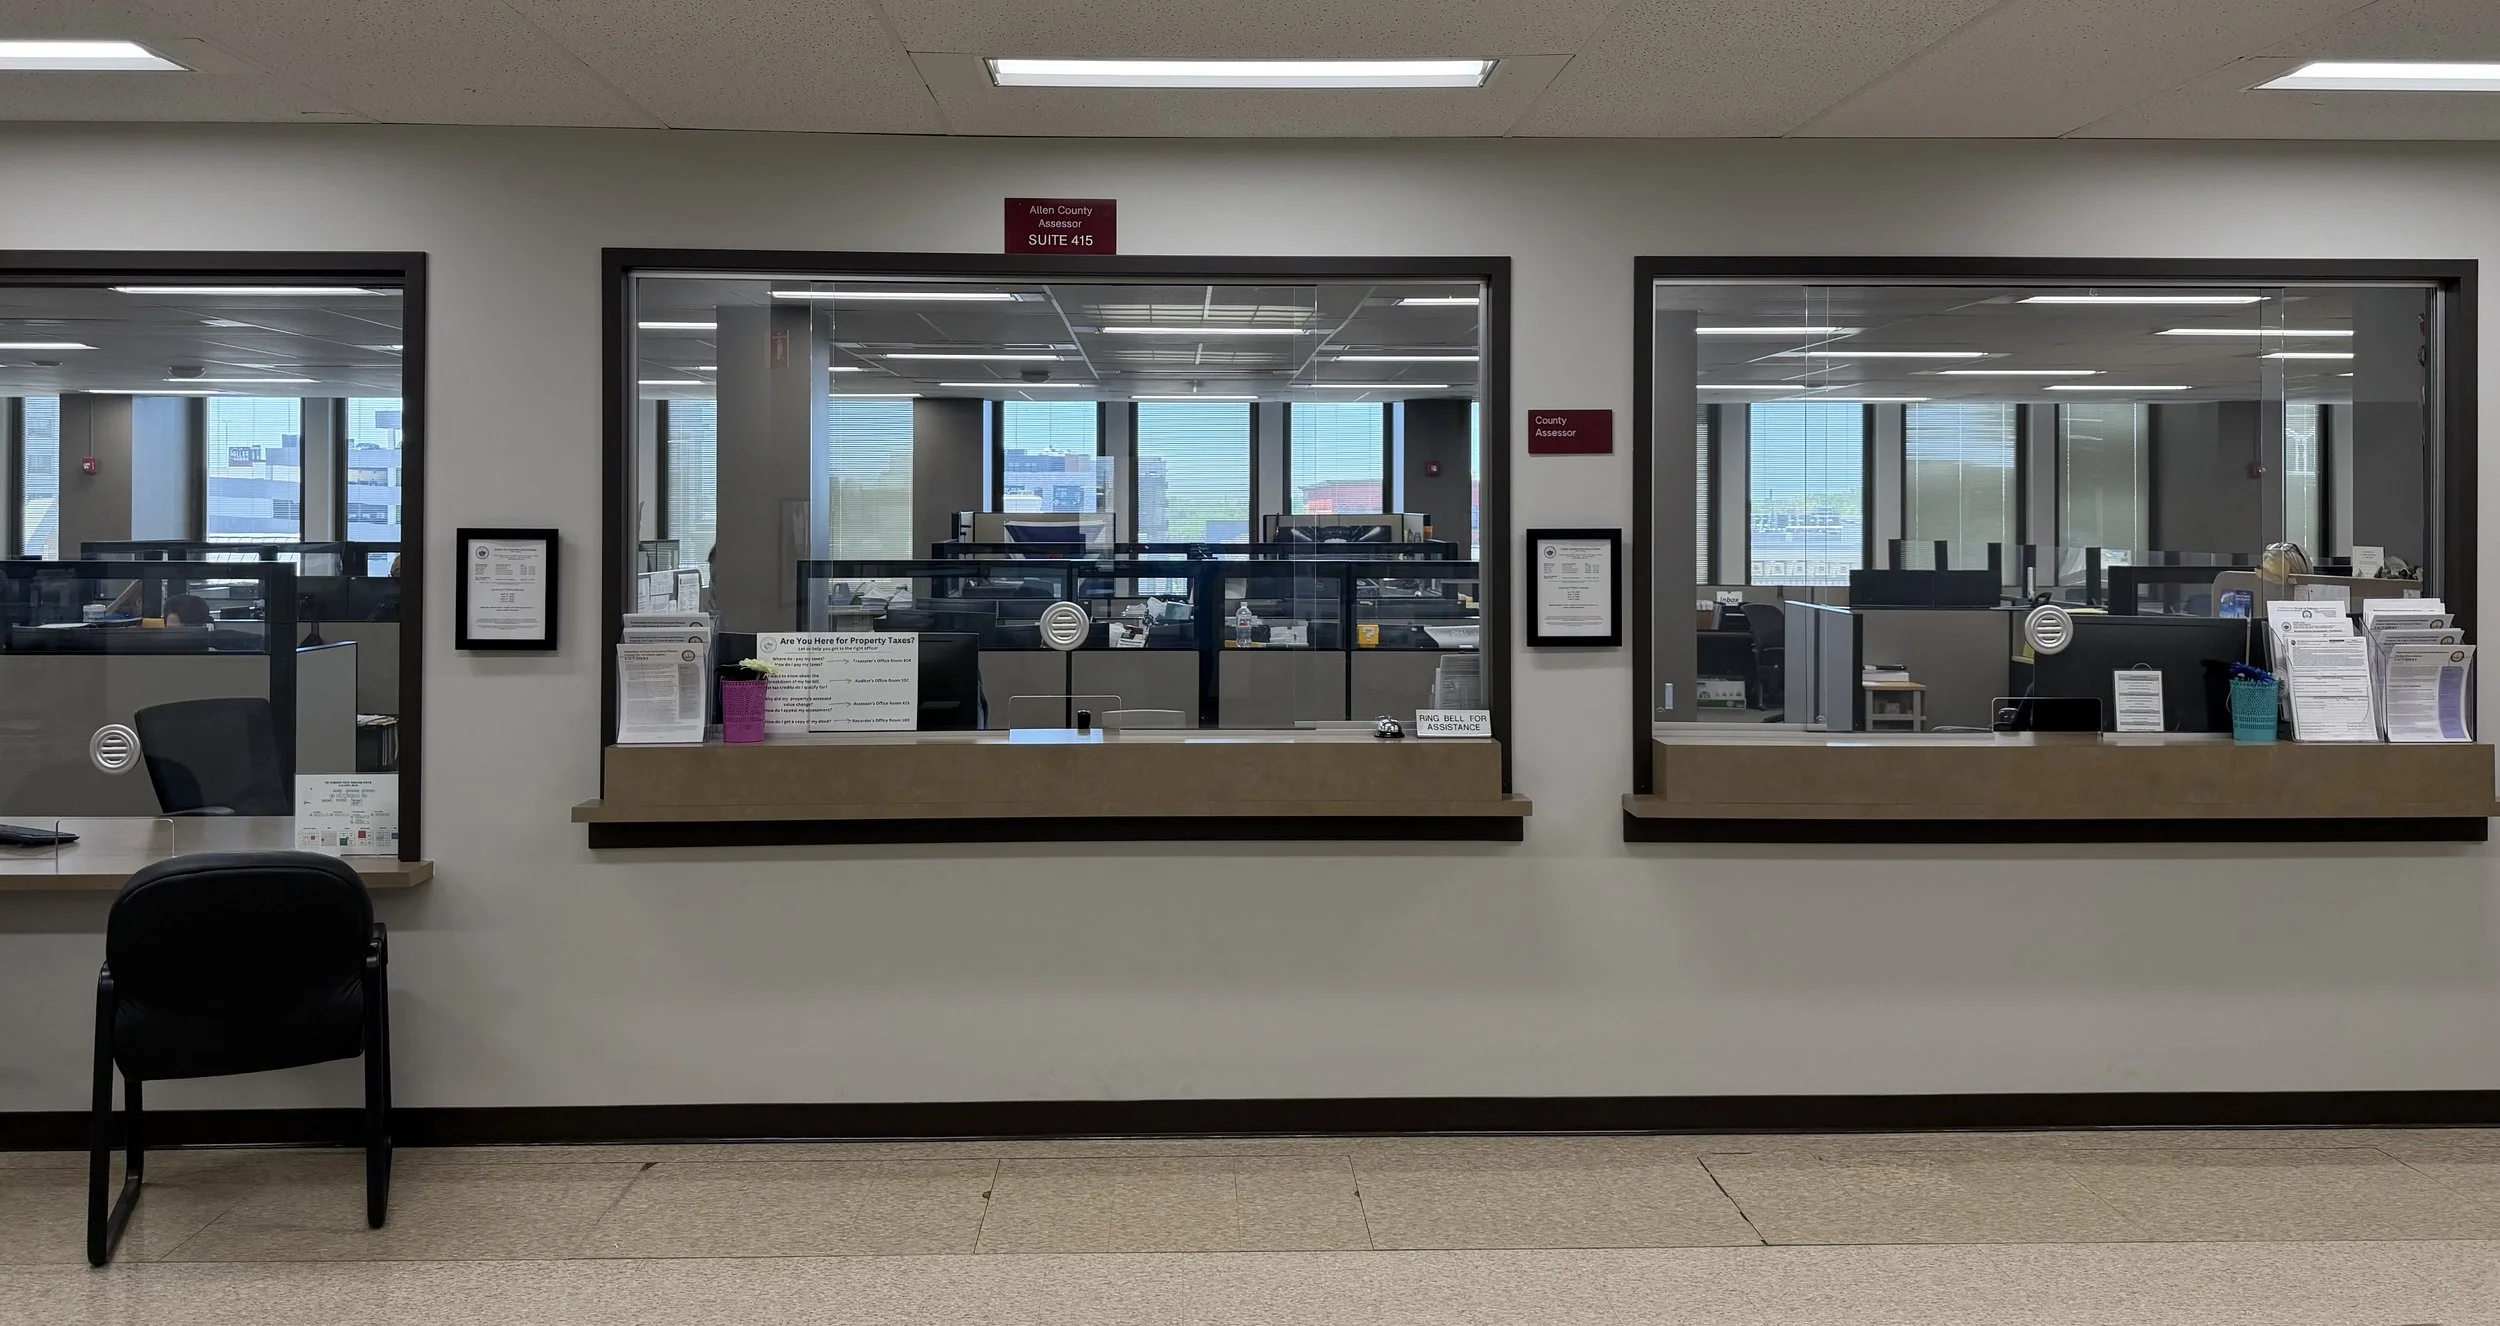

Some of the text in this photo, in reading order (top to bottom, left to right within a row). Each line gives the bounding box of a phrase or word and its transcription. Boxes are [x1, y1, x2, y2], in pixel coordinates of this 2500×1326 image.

[1029, 205, 1093, 216] Allen County
[1038, 219, 1082, 228] Assessor
[1028, 234, 1093, 246] SUITE 415
[1535, 415, 1567, 426] County
[1535, 428, 1576, 437] Assessor
[780, 637, 915, 646] Are You Here for Property Taxes?
